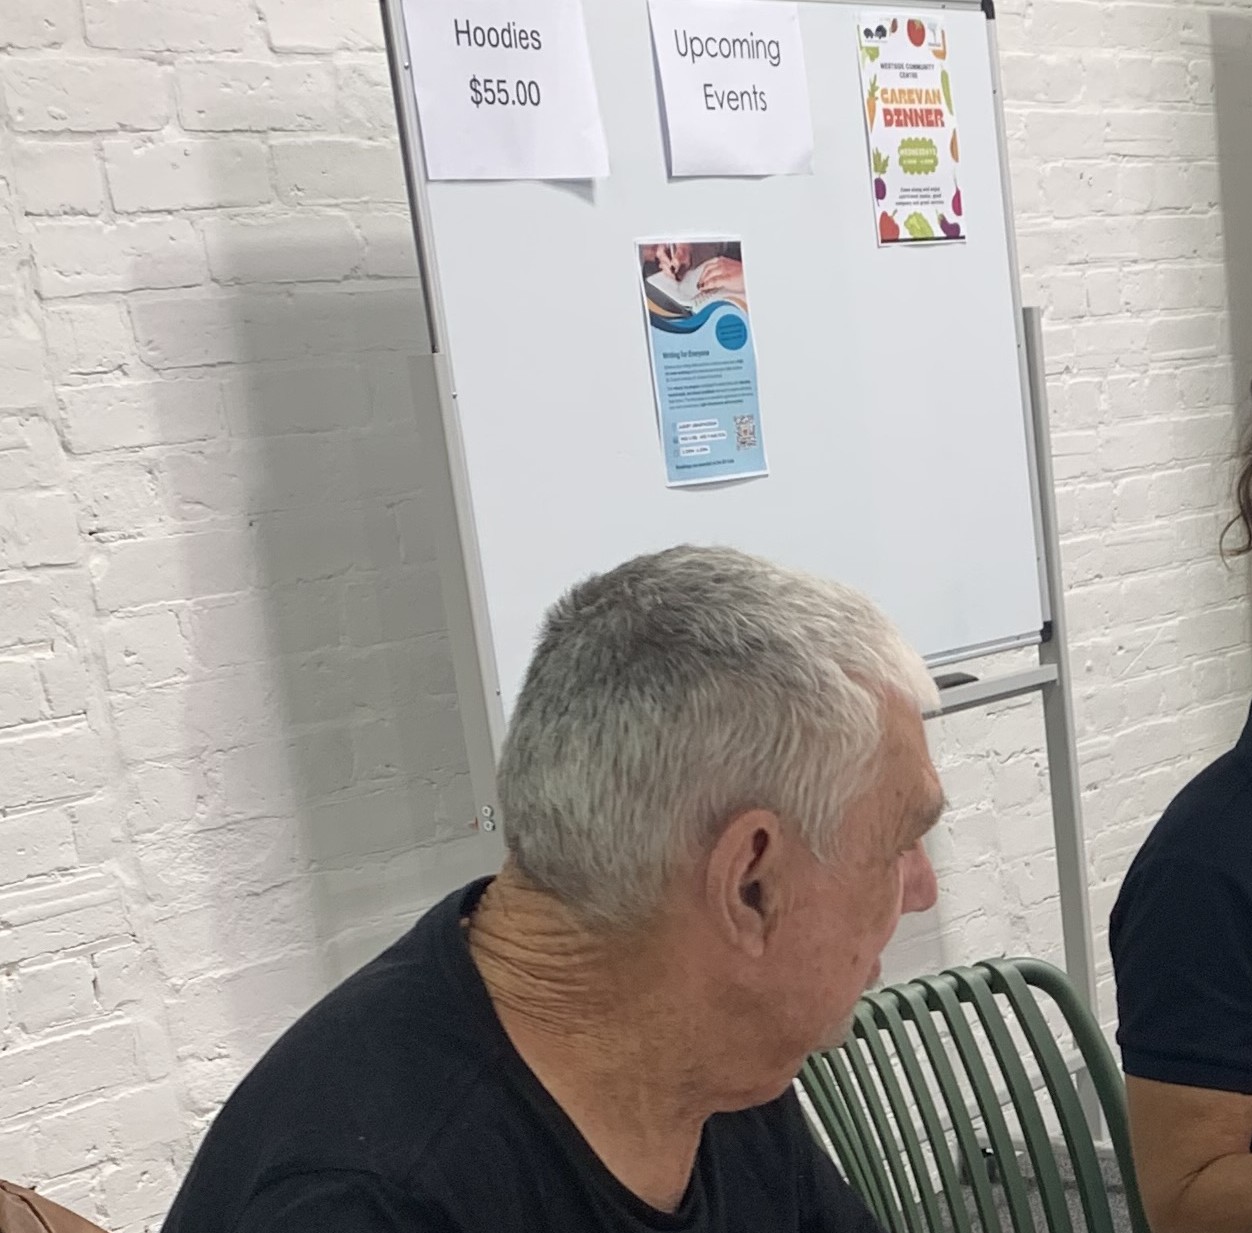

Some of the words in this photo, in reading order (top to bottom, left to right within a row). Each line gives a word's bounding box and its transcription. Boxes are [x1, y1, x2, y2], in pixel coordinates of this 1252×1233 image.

[454, 19, 542, 51] Hoodies
[674, 29, 781, 67] Upcoming
[469, 74, 541, 109] $55.00
[703, 84, 767, 112] Events
[880, 88, 942, 105] CAREVAN
[882, 108, 945, 127] DINNER
